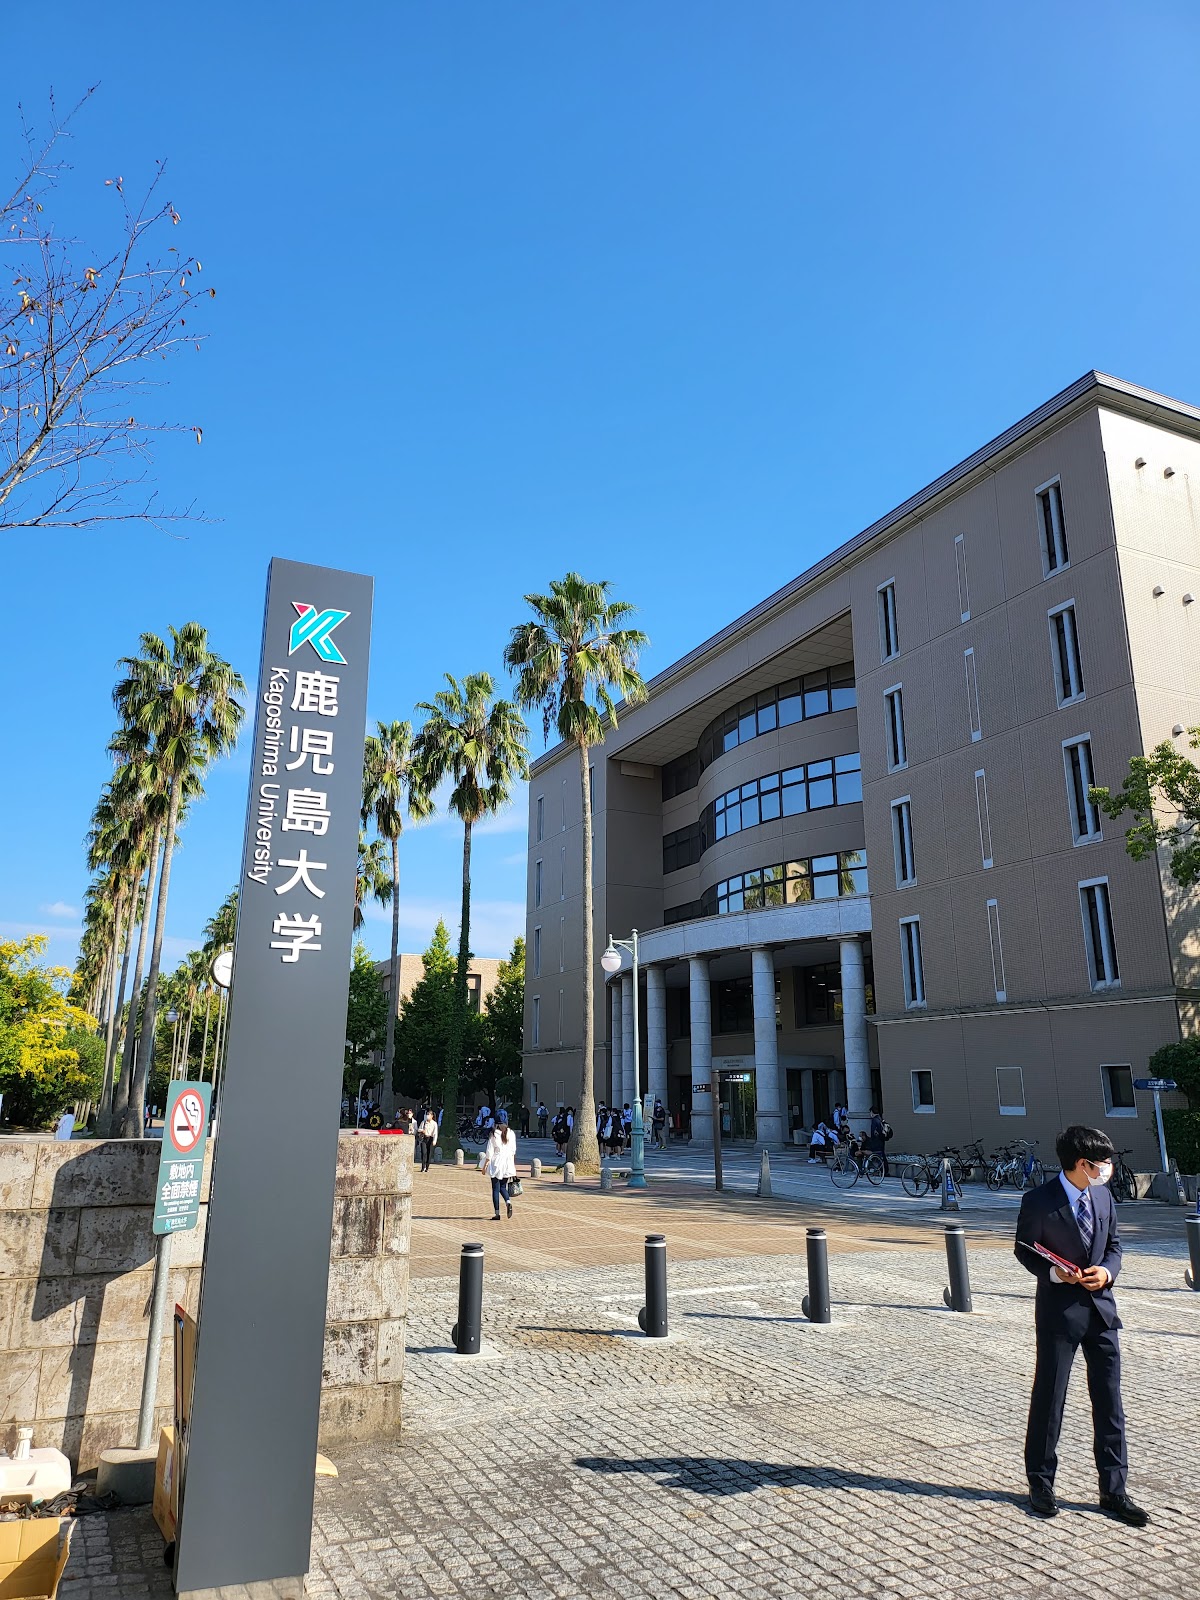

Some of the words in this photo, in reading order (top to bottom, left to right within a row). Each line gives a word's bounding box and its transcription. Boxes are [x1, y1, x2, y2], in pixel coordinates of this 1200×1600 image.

[261, 665, 290, 777] Kagoshima
[247, 783, 281, 886] University
[270, 669, 340, 963] 鹿児島大学
[161, 1180, 198, 1200] 全面禁煙
[169, 1163, 194, 1180] 敷地内
